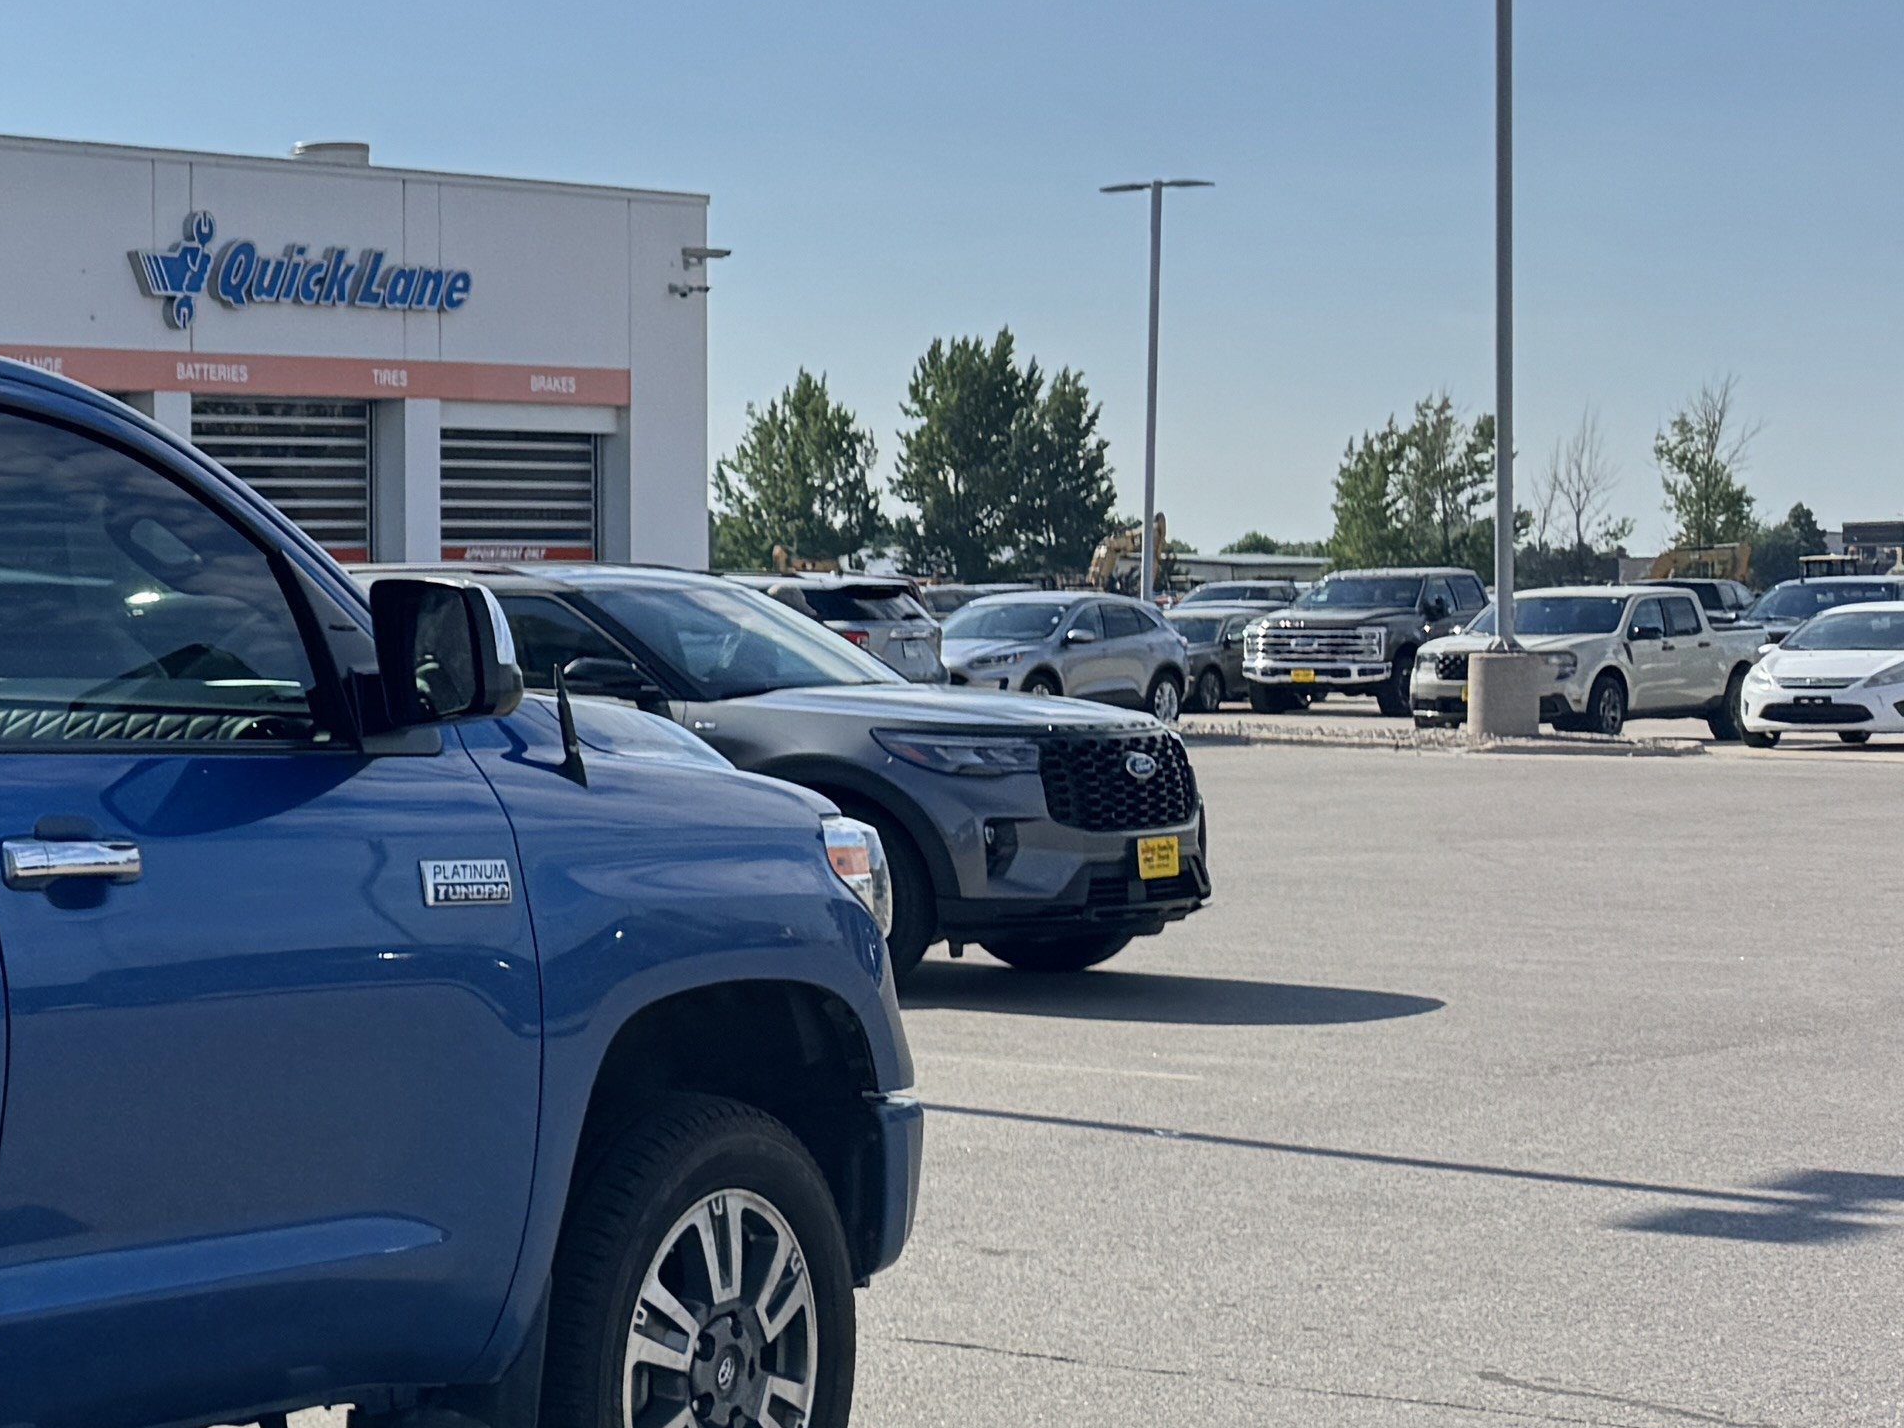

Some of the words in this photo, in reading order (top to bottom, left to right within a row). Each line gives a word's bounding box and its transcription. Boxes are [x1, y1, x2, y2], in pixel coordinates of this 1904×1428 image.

[176, 362, 249, 383] BATTERIES
[372, 368, 408, 387] TIRES
[530, 375, 577, 394] BRAKES
[433, 863, 506, 880] PLATINUM
[436, 882, 509, 901] TUNDRA
